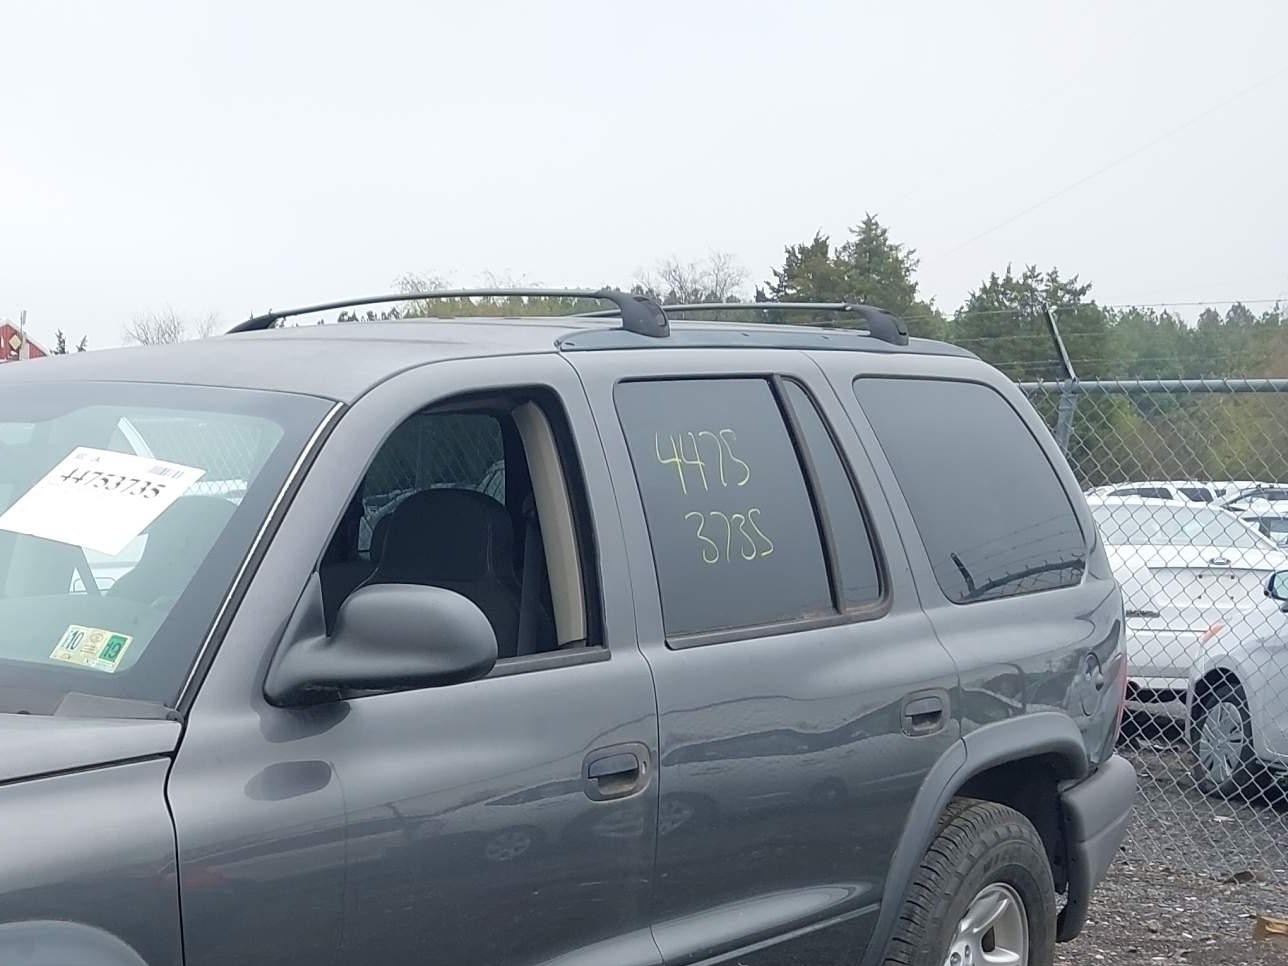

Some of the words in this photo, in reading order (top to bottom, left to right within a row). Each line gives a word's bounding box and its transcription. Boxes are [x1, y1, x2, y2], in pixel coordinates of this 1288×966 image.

[60, 467, 167, 499] 44753735
[655, 428, 751, 495] 4475
[684, 507, 774, 563] 3735
